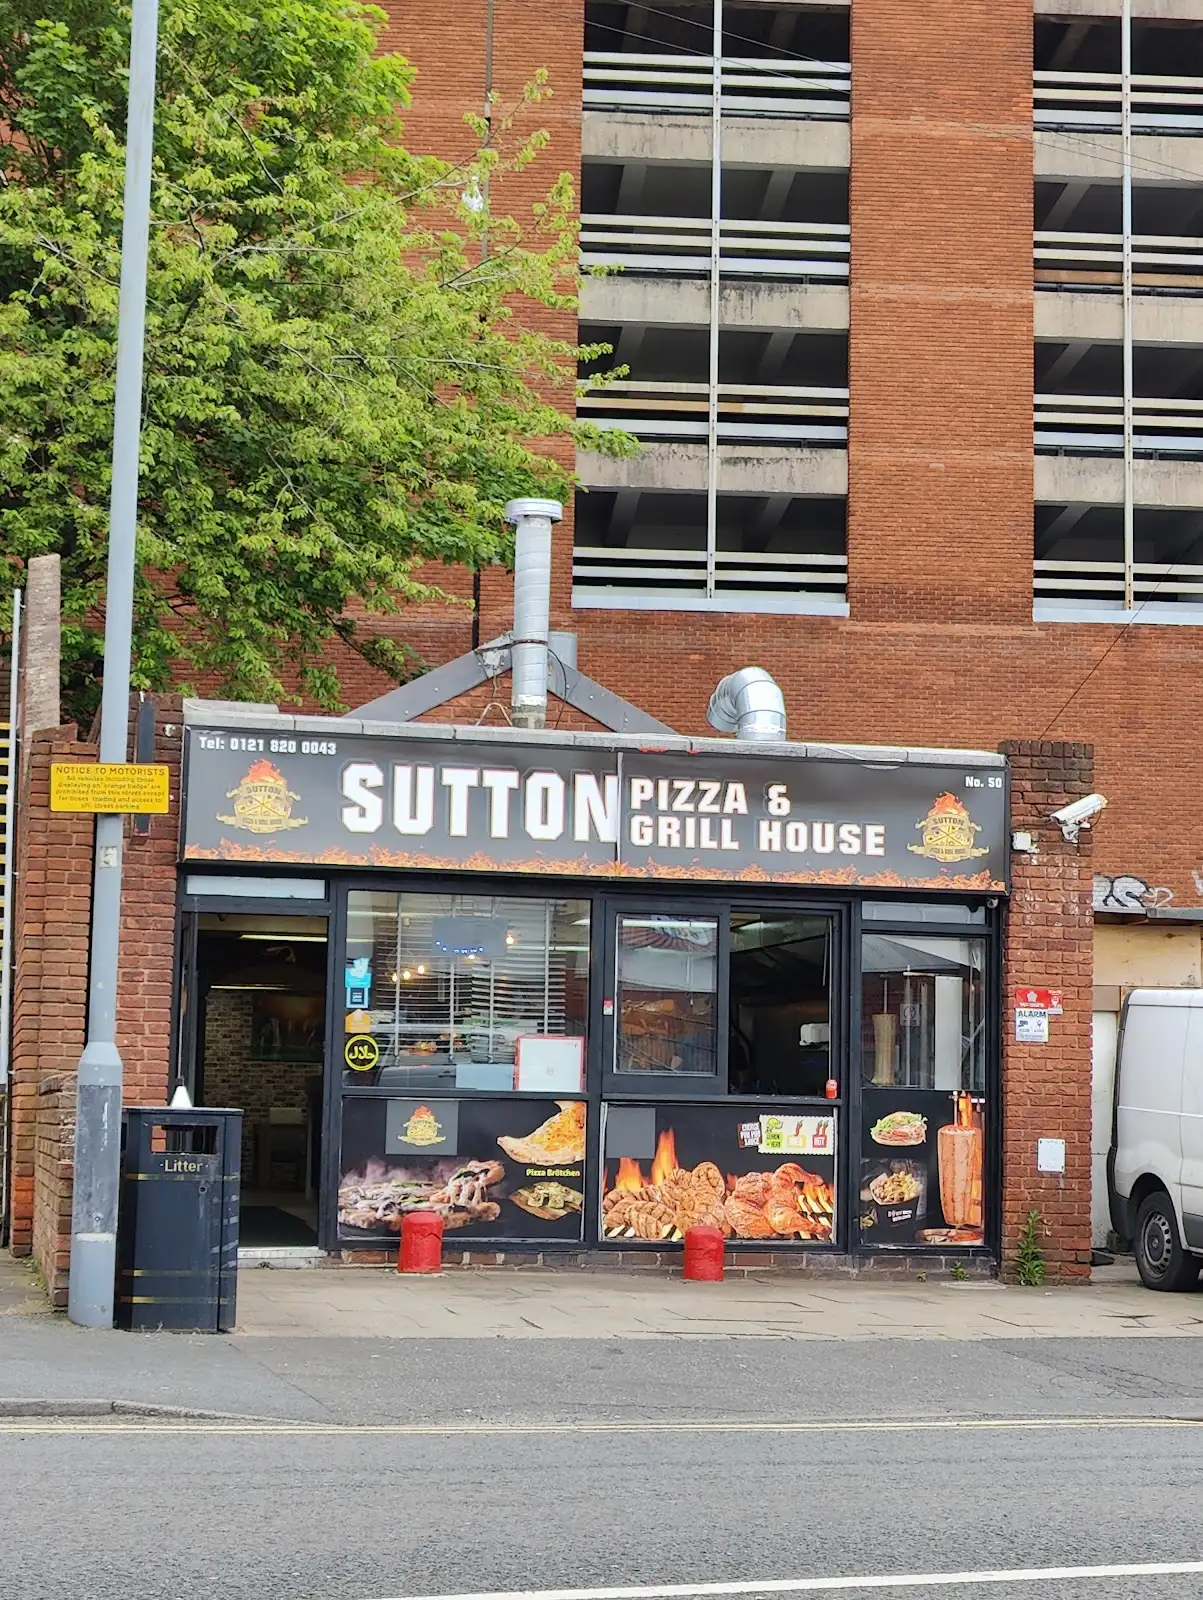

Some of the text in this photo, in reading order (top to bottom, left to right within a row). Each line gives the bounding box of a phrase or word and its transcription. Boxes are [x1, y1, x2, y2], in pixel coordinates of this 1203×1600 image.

[199, 736, 337, 755] Tel: 0121 820 0043
[56, 766, 165, 776] NOTICE TO MOTORISTS
[964, 775, 1003, 789] No. 50
[244, 784, 283, 796] SUTTON
[341, 762, 618, 843] SUTTON
[629, 777, 791, 817] PIZZA &
[931, 816, 965, 827] SUTTON
[629, 814, 886, 857] GRILL HOUSE
[1018, 1010, 1047, 1018] ALARM
[348, 1044, 376, 1060] حلال
[164, 1159, 203, 1172] Litter
[526, 1168, 581, 1177] Pizza Brötchen
